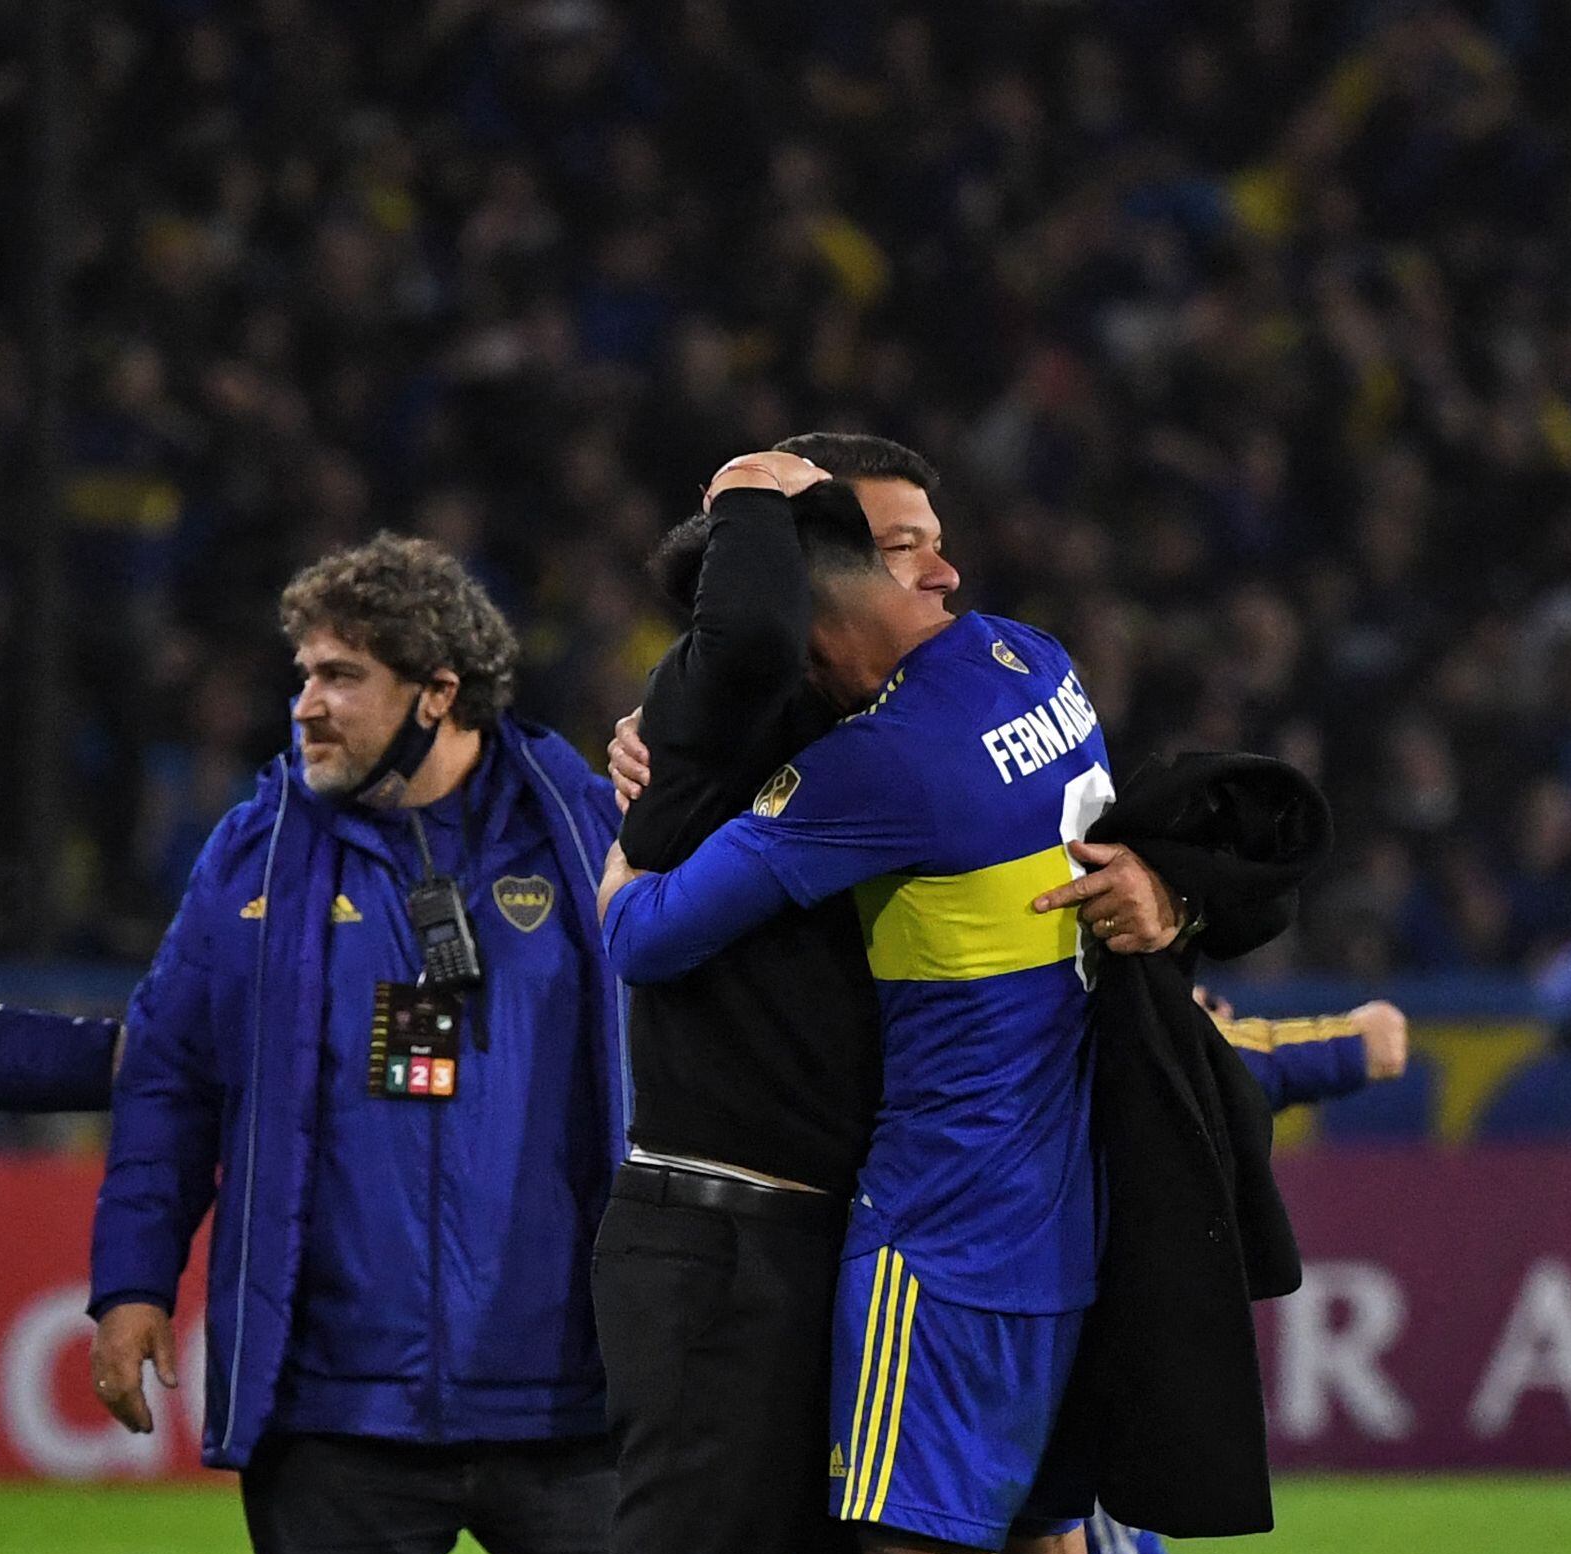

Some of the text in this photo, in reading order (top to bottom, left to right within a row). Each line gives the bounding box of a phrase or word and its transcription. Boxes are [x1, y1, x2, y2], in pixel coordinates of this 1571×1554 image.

[981, 669, 1097, 785] FERNADE
[390, 1064, 452, 1089] 1 2 3
